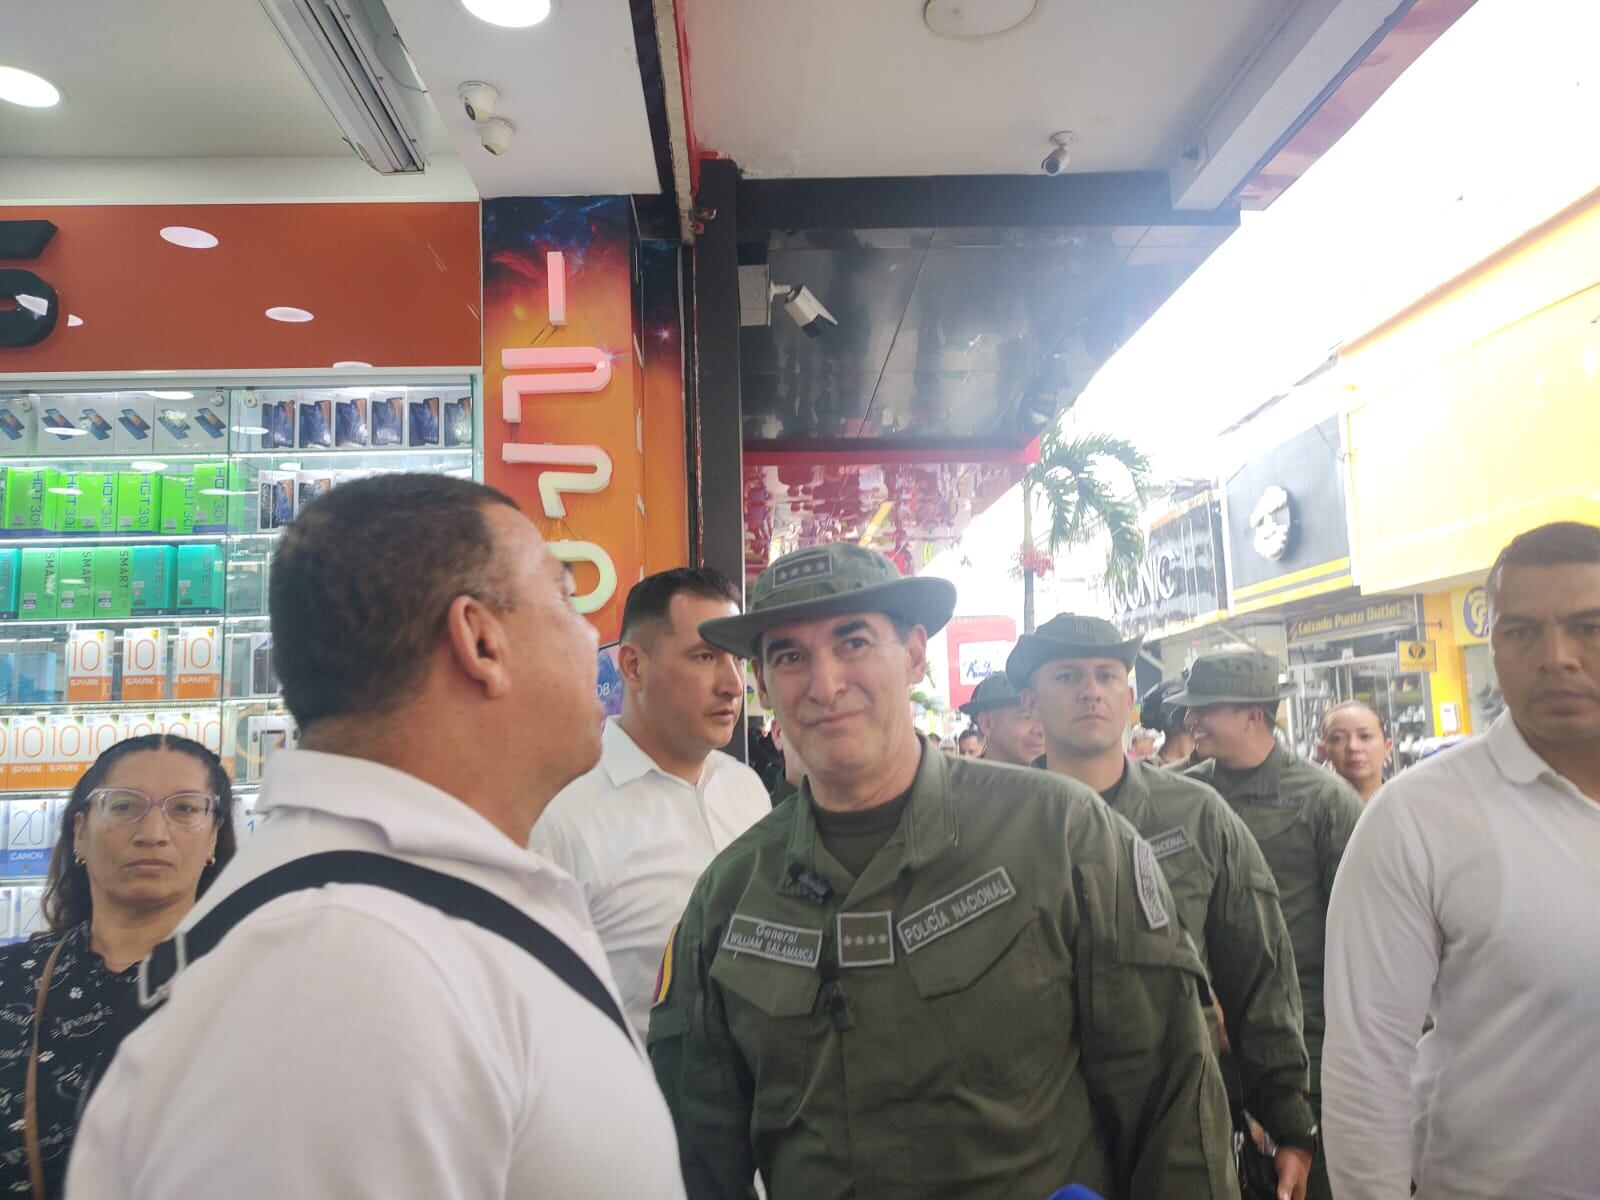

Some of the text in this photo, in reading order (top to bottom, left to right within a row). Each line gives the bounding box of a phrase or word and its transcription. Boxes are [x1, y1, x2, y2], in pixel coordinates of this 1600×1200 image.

[32, 471, 43, 503] HOT
[102, 474, 114, 506] HOT
[140, 472, 151, 506] HOT
[81, 551, 91, 591] SMART
[120, 550, 129, 589] SMART
[1298, 601, 1400, 634] Calzado Punto Outlet
[71, 640, 101, 671] 10
[126, 638, 156, 671] 10
[182, 637, 212, 669] 10
[71, 679, 99, 687] SPARK
[126, 677, 154, 686] SPARK
[181, 676, 209, 684] SPARK
[14, 726, 43, 758] 10
[50, 724, 81, 757] 10
[12, 764, 42, 773] SPARK
[49, 763, 80, 773] SPARK
[11, 809, 46, 846] 20
[10, 851, 44, 860] CAMON
[904, 879, 1010, 945] POLICÍA NACIONAL
[730, 933, 815, 962] WILLIAM SALAMANCA
[755, 923, 799, 945] General
